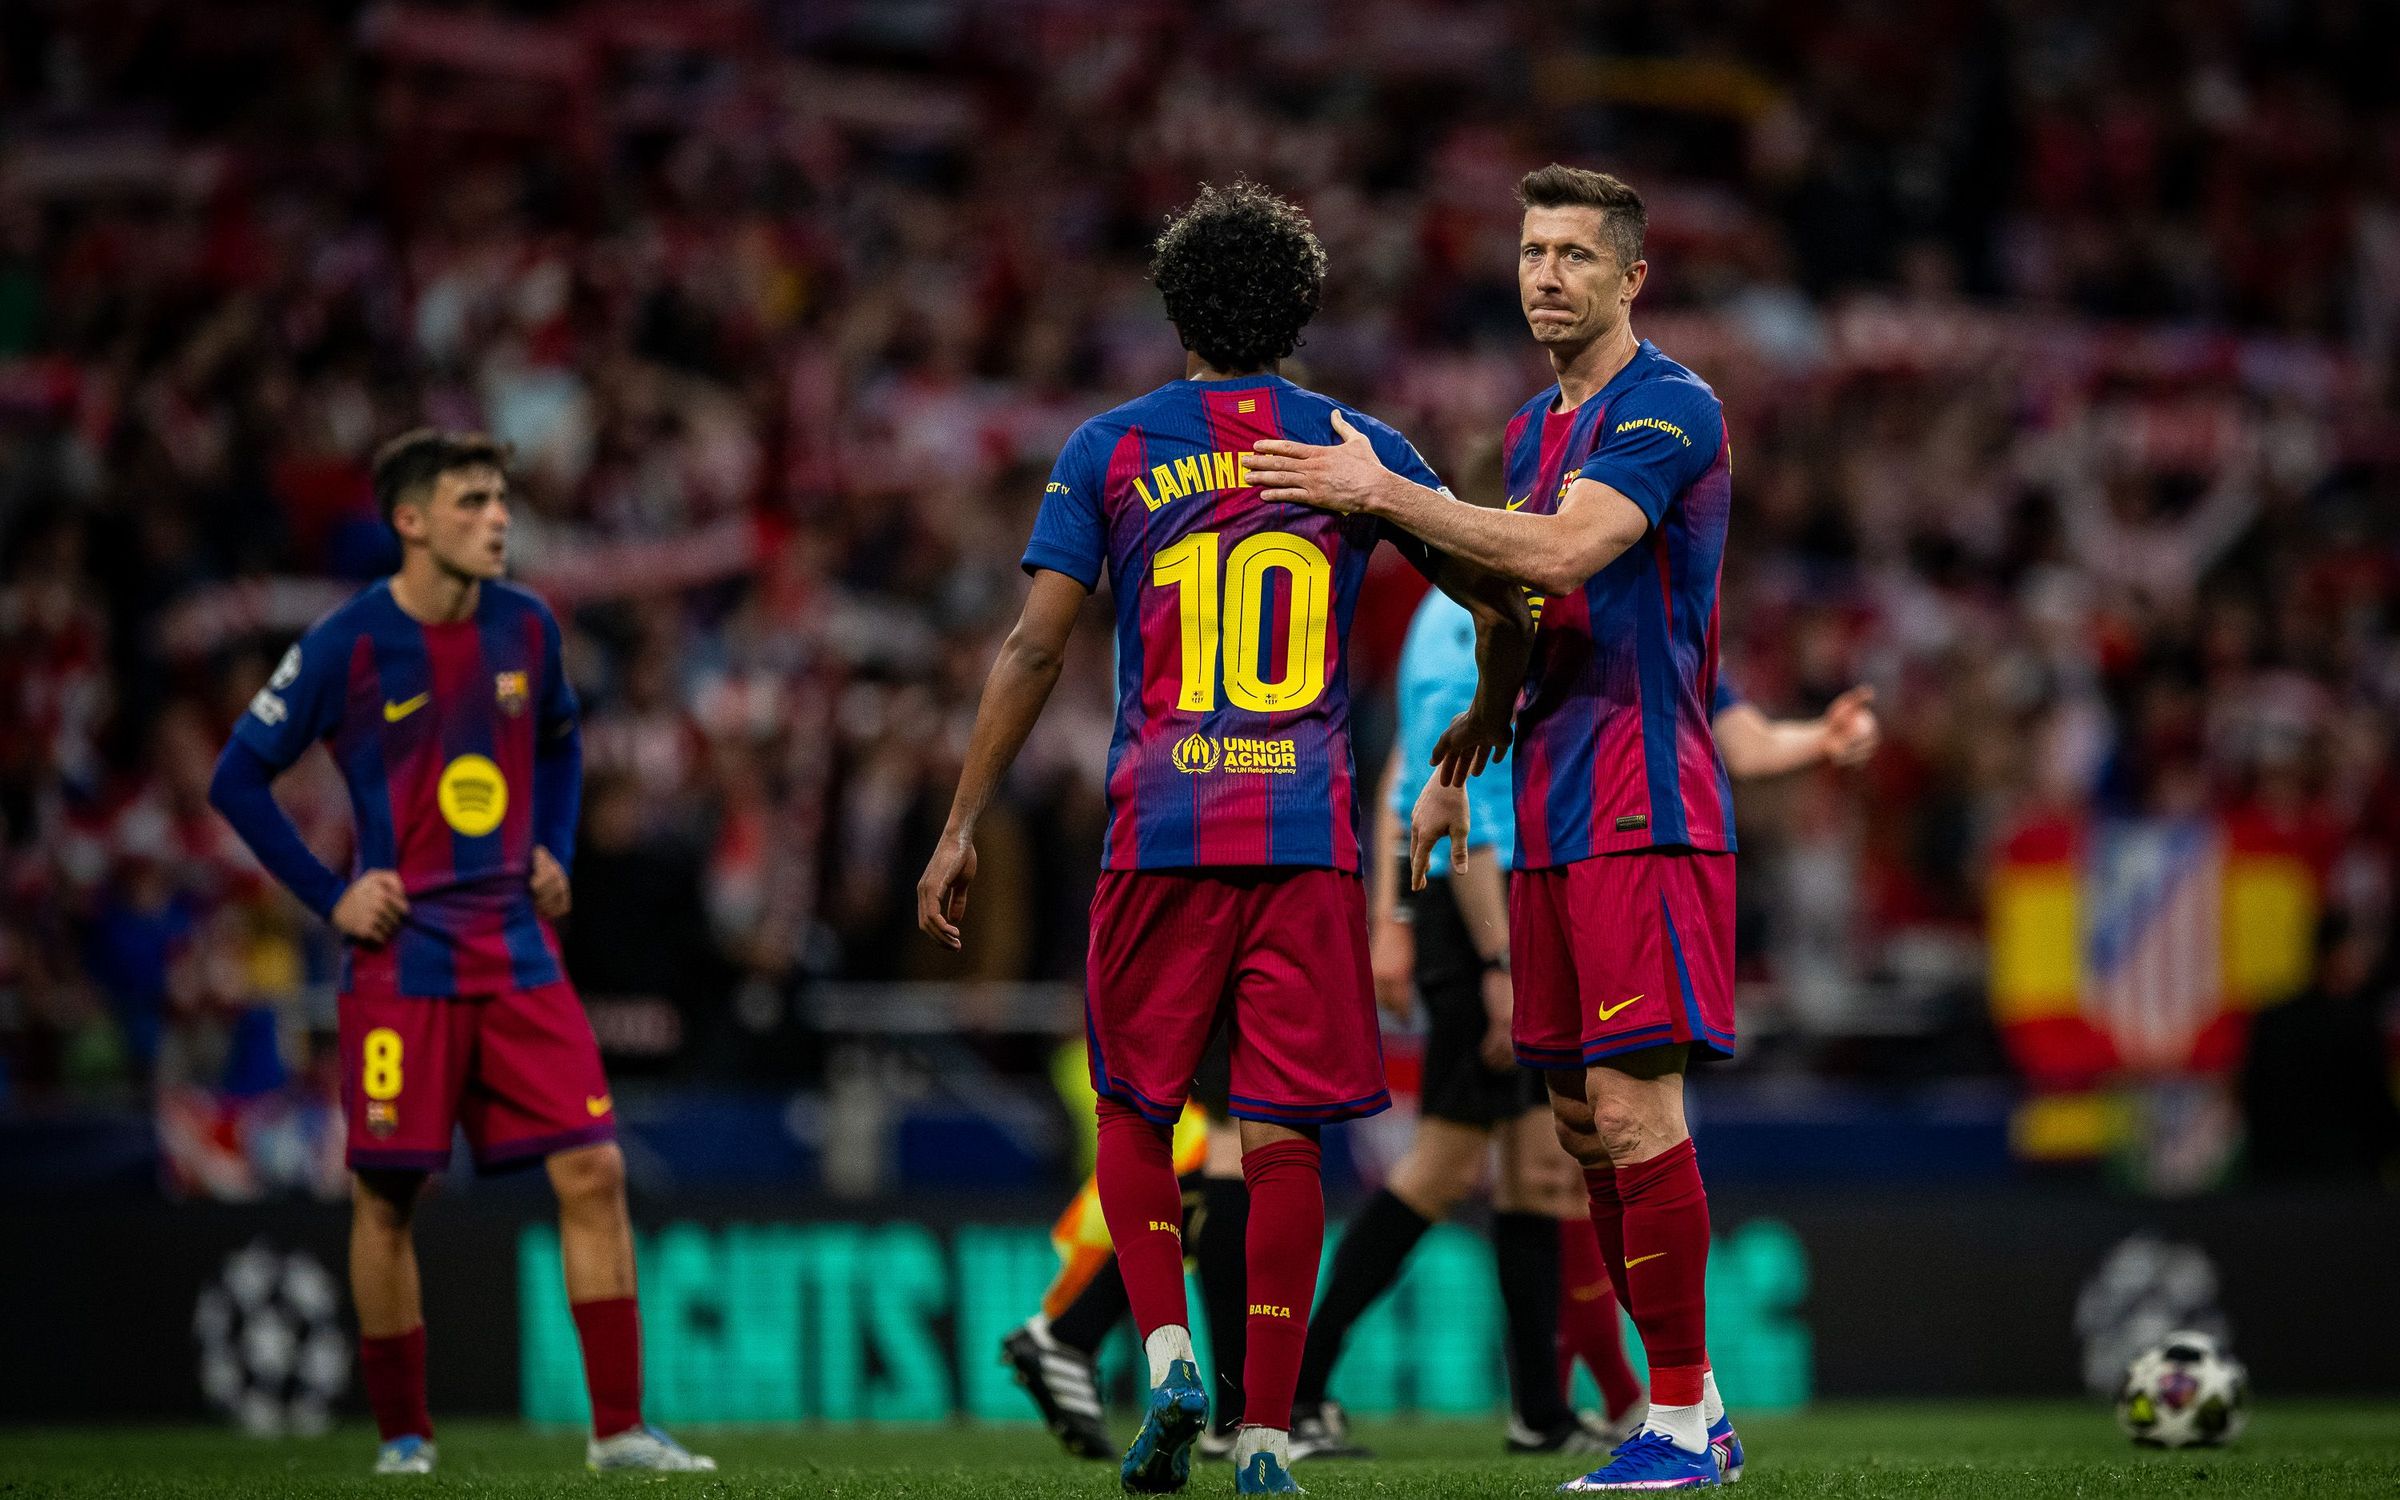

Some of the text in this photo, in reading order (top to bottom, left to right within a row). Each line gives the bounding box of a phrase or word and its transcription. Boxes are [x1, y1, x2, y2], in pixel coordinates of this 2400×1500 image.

[1616, 418, 1692, 447] AMBILIGHT tv
[1153, 532, 1331, 713] 10
[1223, 737, 1295, 754] UNHCR
[1223, 752, 1297, 767] ACNUR
[1248, 767, 1273, 775] Refugee
[1274, 767, 1297, 775] Agency
[363, 1026, 404, 1100] 8
[1249, 1304, 1291, 1318] BARÇA
